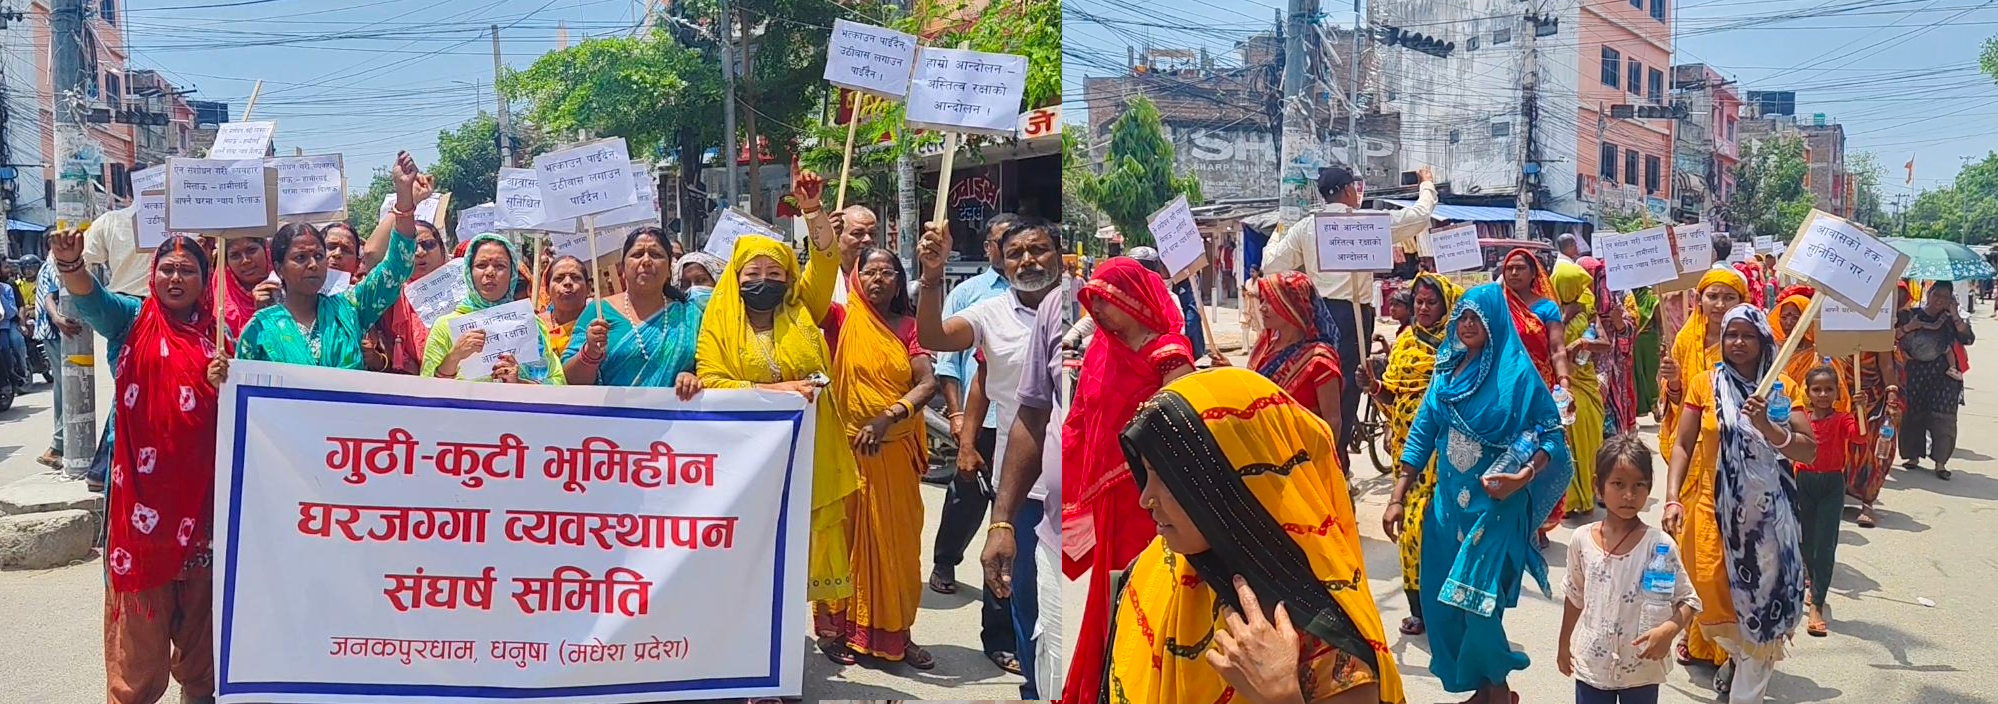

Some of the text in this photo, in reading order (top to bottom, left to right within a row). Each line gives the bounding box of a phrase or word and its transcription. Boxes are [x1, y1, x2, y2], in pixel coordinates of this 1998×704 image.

[873, 53, 904, 67] लगाउन
[956, 59, 1003, 74] आन्दोलन
[927, 76, 1008, 96] अस्तित्व रक्षाको
[934, 98, 982, 115] आन्दोलन
[548, 168, 621, 191] उठीवास लगाउन
[1344, 221, 1374, 232] आन्दोलन
[1358, 236, 1382, 247] रक्षाको
[1816, 224, 1862, 251] आवासको
[1337, 252, 1368, 261] आन्दोलन
[1806, 242, 1847, 268] सुनिश्चित
[1849, 262, 1865, 280] गर
[482, 312, 517, 326] आन्दोलन
[326, 428, 719, 494] गुठी-कुटी भूमिहीन
[297, 501, 739, 552] घरजग्गा व्यवस्थापन
[383, 565, 654, 619] संघर्ष समिति
[329, 635, 690, 668] जनकपुरधाम, धनुषा (मधेश प्रदेश)
